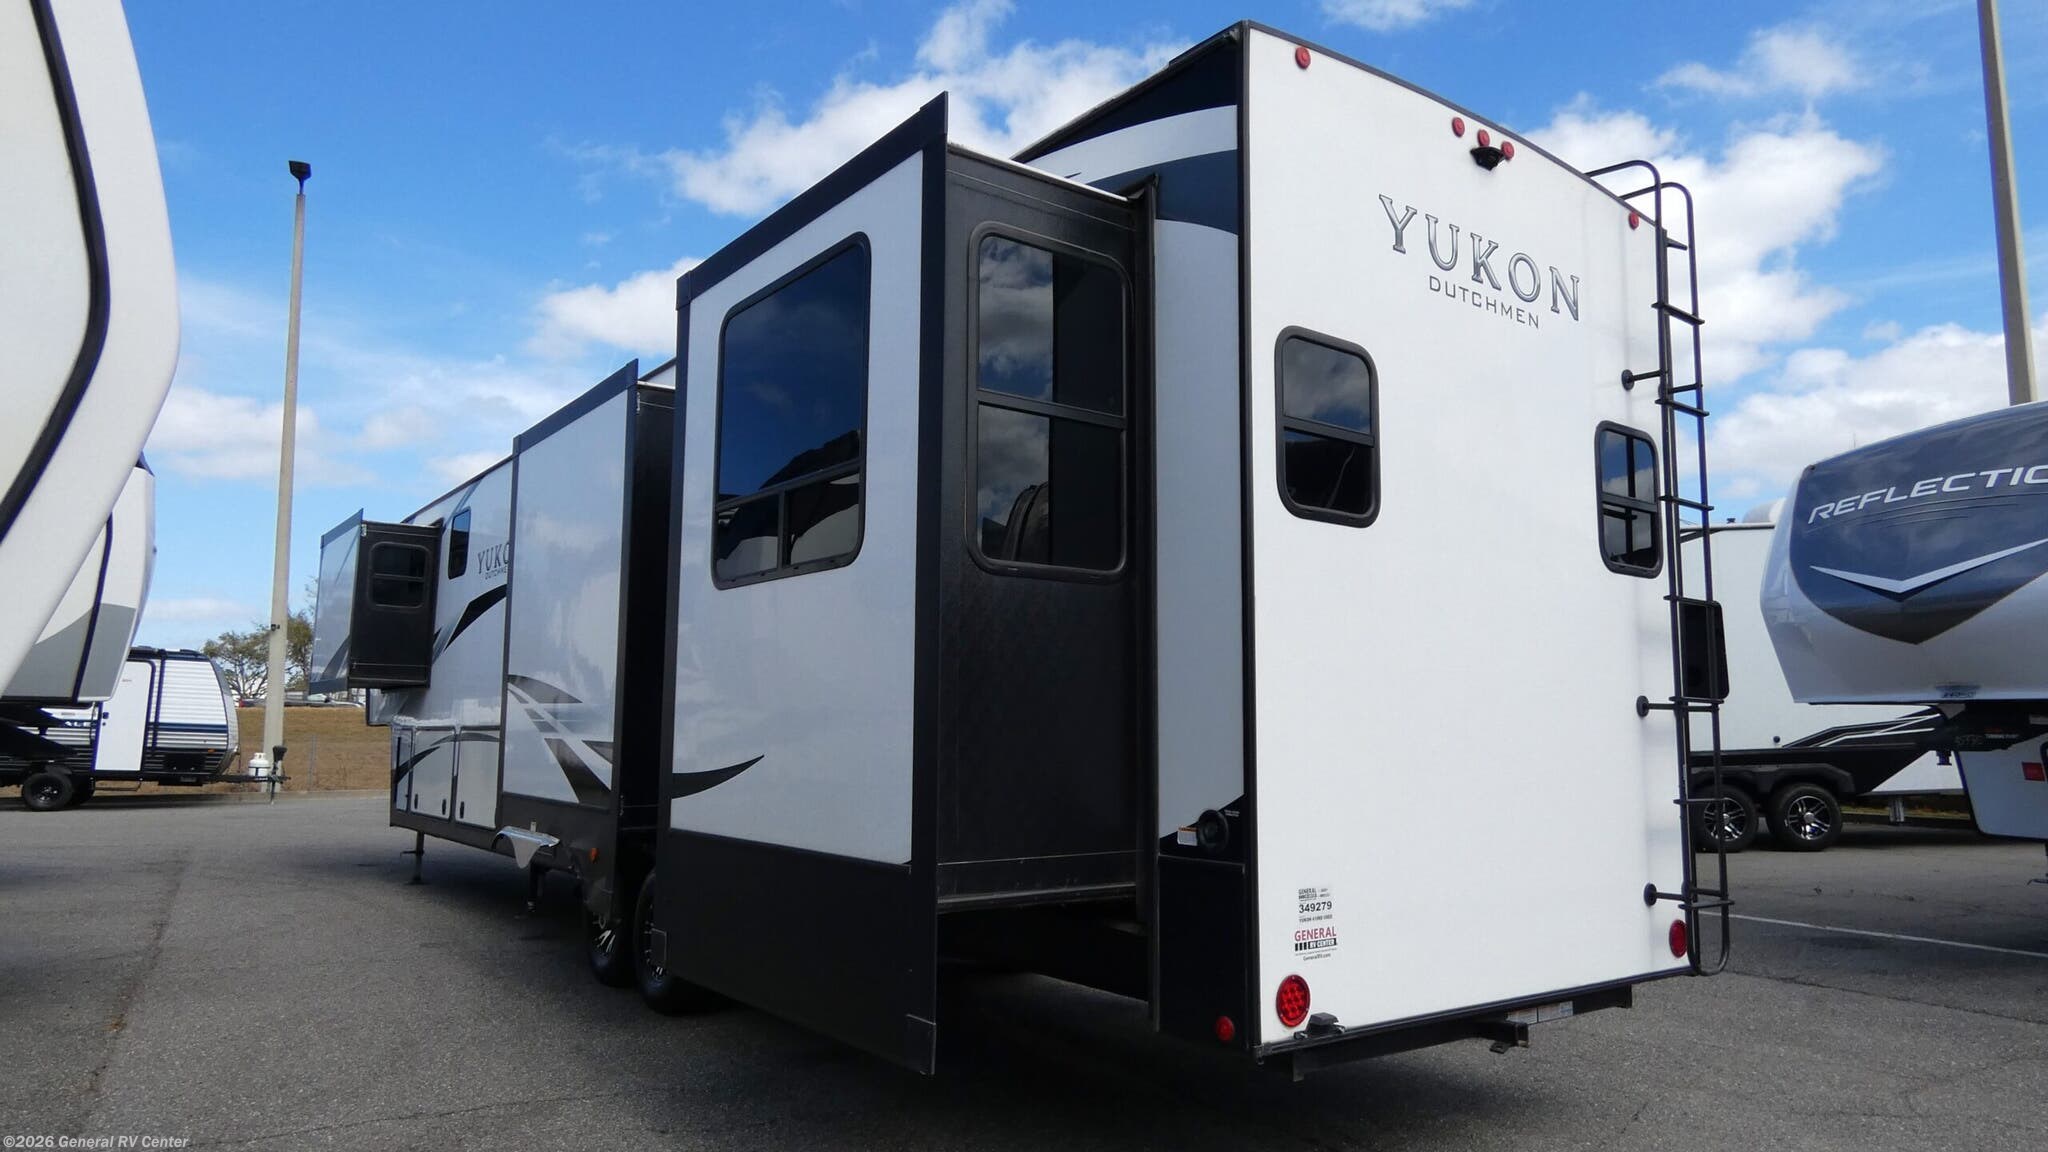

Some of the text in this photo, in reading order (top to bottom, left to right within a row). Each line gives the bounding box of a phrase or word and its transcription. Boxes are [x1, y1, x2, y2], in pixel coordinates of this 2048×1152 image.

[1379, 194, 1579, 321] YUKON
[1429, 275, 1539, 329] DUTCHMEN
[1299, 901, 1333, 914] 349279
[1295, 926, 1336, 941] GENERAL
